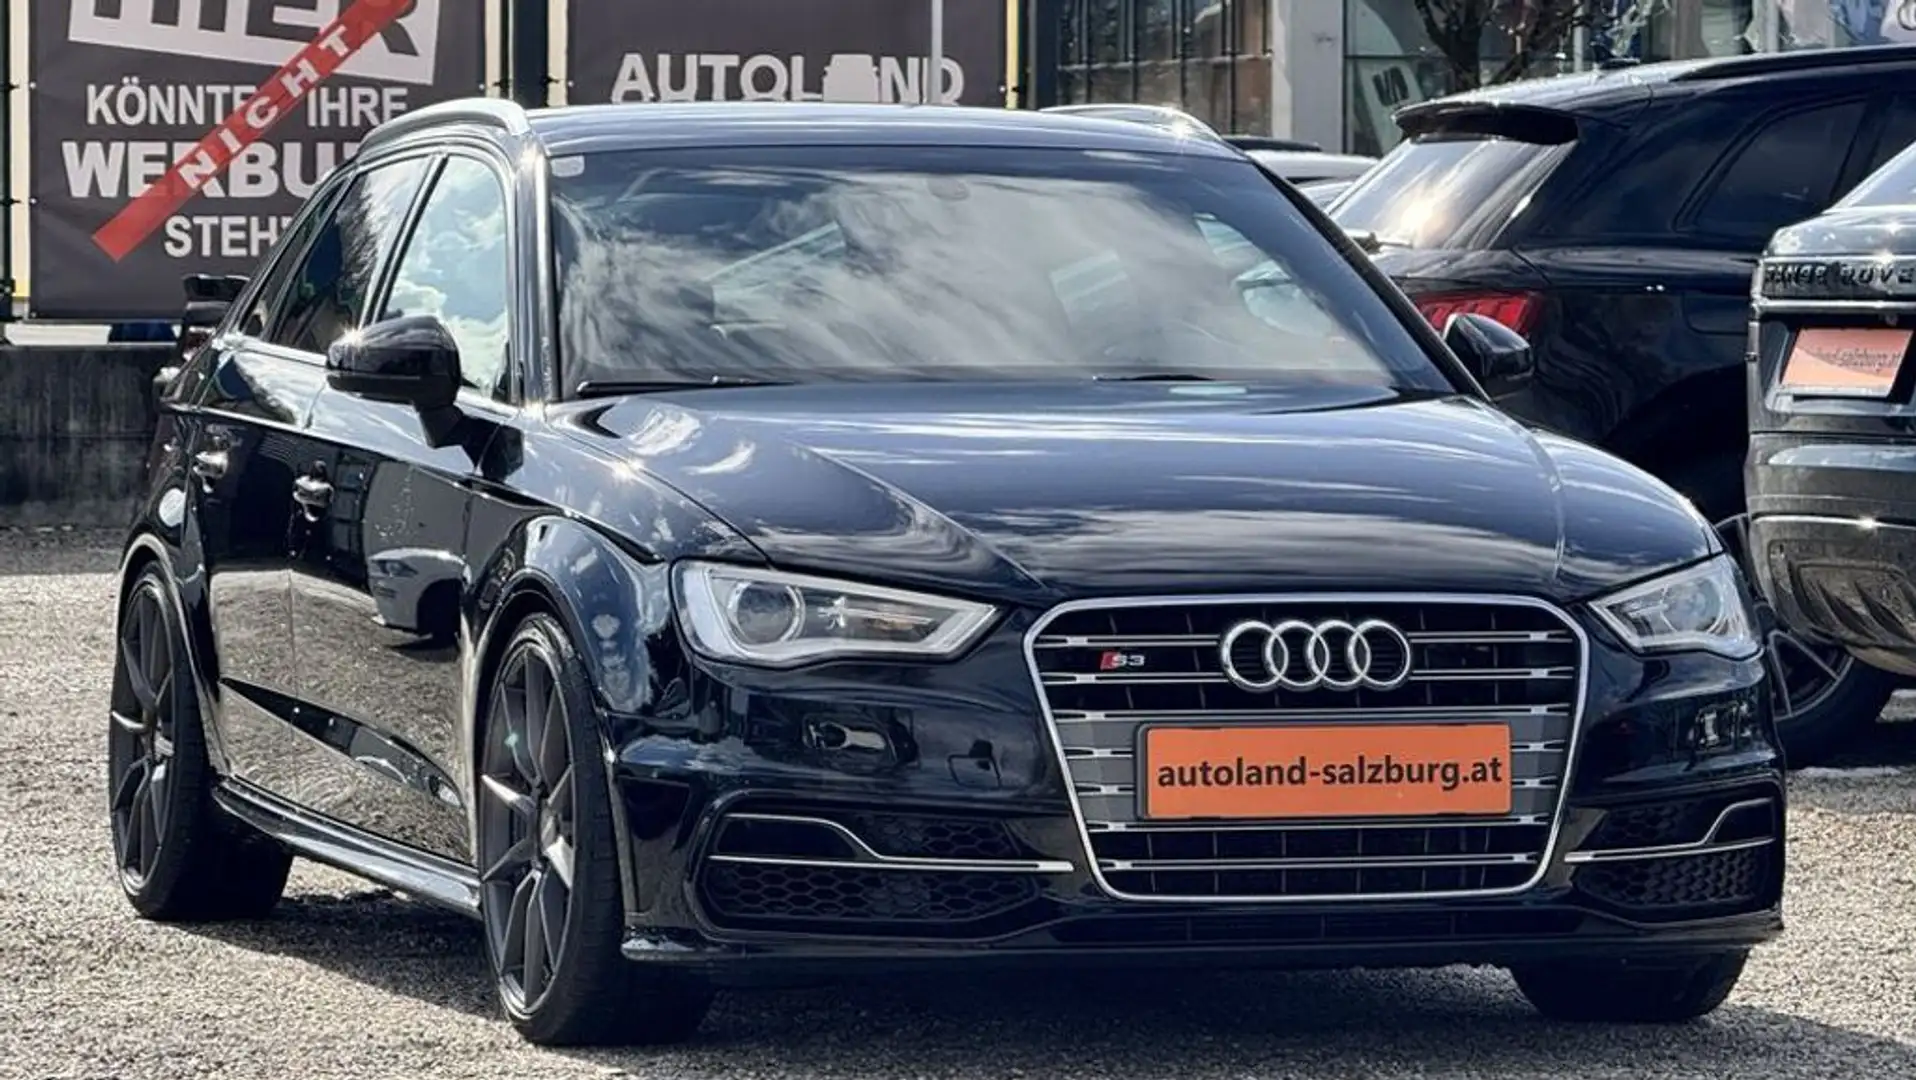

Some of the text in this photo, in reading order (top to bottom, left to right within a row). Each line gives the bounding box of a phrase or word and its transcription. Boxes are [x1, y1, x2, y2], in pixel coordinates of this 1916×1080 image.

[178, 25, 350, 190] NICHT
[308, 87, 407, 127] IHRE
[164, 215, 292, 258] STEH
[1111, 652, 1146, 668] S3
[1157, 755, 1503, 791] autoland-salzburg.at
